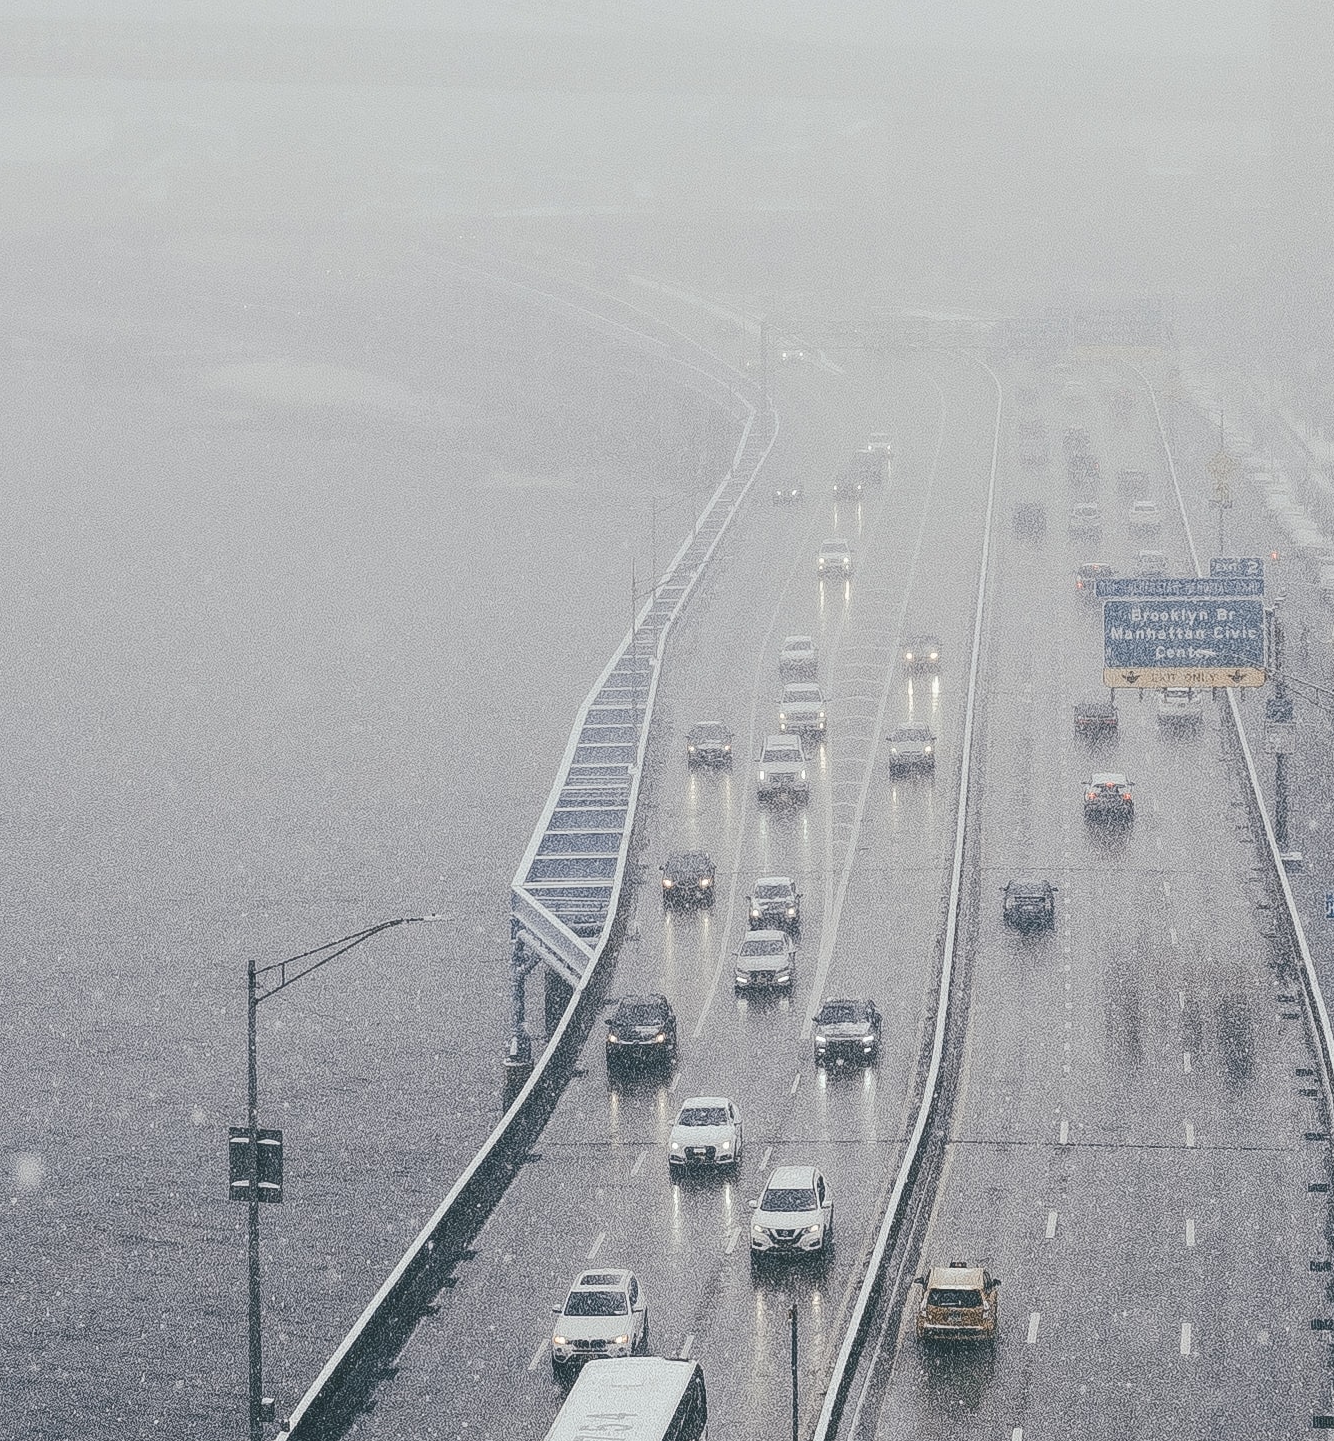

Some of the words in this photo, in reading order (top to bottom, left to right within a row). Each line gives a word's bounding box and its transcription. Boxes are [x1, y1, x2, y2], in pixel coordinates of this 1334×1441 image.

[1247, 560, 1259, 575] 2
[1131, 608, 1209, 625] Brooklyn
[1216, 608, 1236, 621] Br
[1110, 627, 1205, 640] Manhattan
[1212, 626, 1257, 640] Civic
[1184, 672, 1217, 683] ONLY
